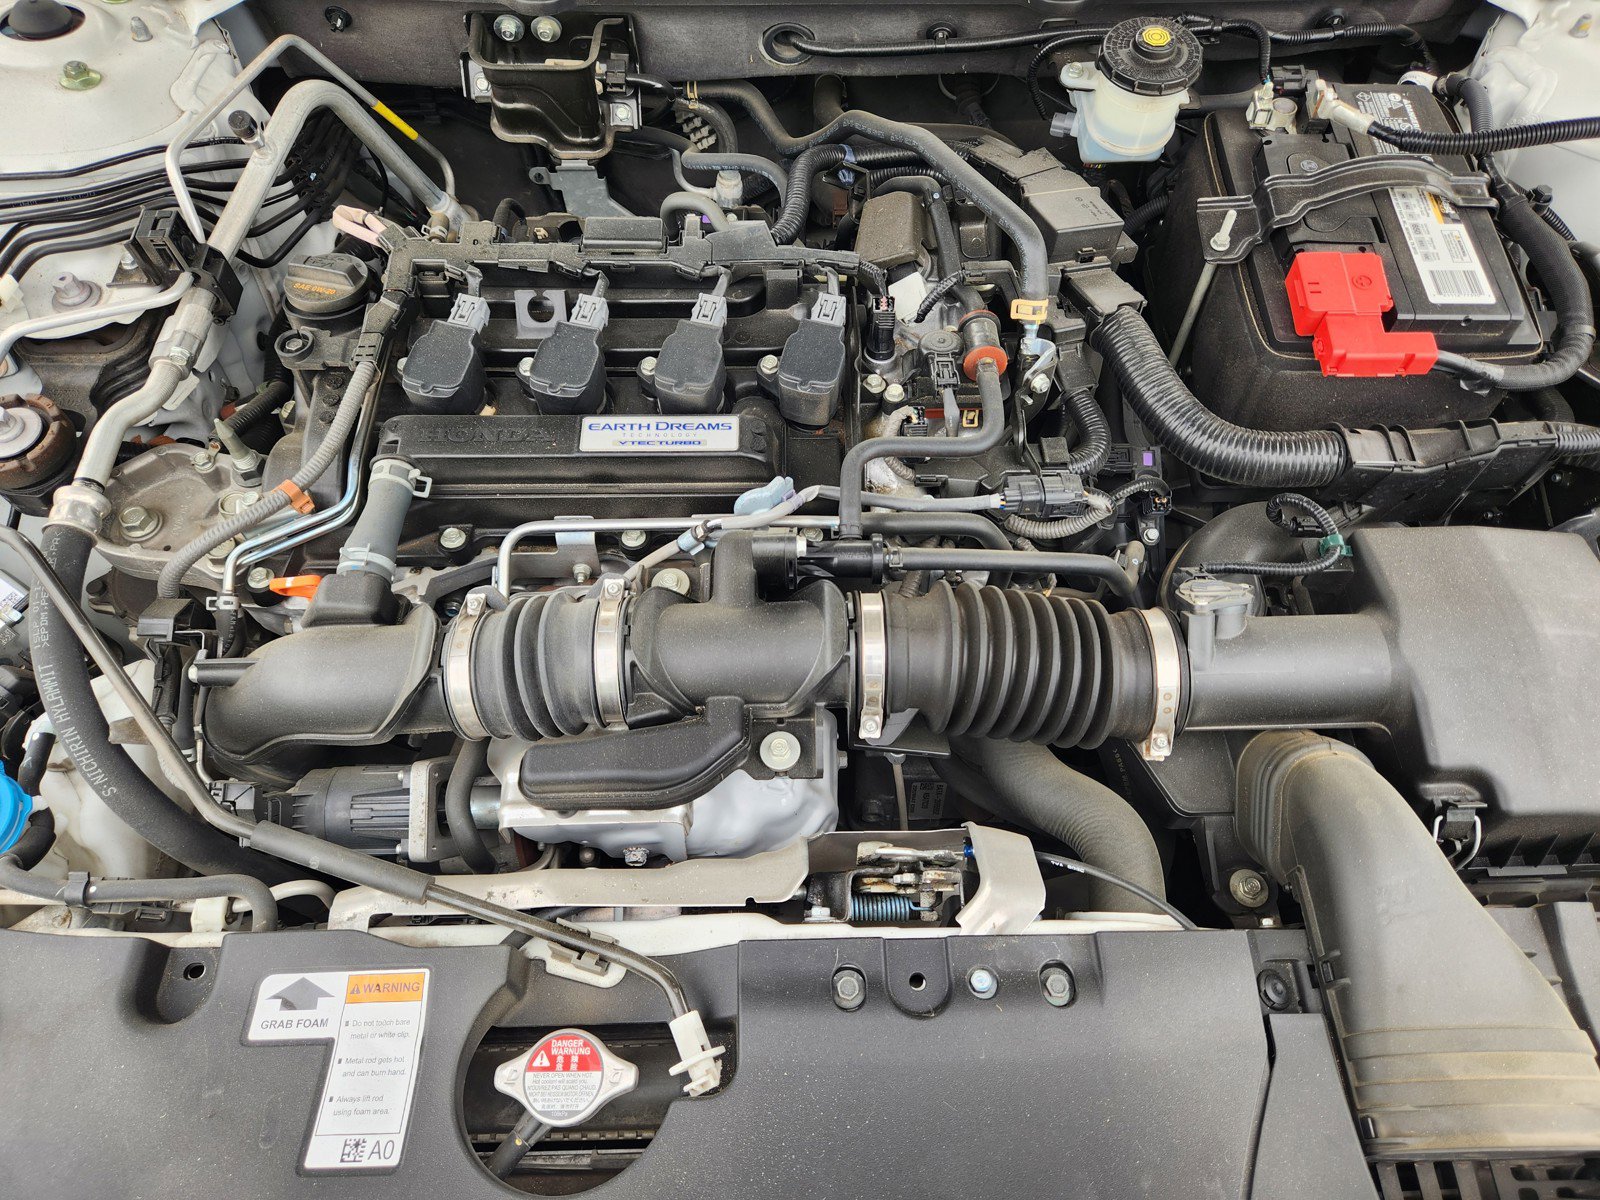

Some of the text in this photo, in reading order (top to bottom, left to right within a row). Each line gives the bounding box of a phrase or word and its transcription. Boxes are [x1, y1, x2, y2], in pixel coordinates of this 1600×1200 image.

[293, 282, 337, 295] SAE 0W-20
[588, 421, 733, 431] EARTH DREAMS
[417, 427, 551, 443] HONDA
[38, 663, 71, 725] HYLAMMIT
[363, 982, 420, 994] WARNING
[260, 1018, 329, 1030] GRAB FOAM
[396, 1018, 410, 1026] bare
[552, 1039, 584, 1048] DANGER
[551, 1047, 591, 1056] WARNUNG
[378, 1057, 392, 1065] gets
[336, 1096, 362, 1104] Always
[372, 1094, 384, 1102] rod
[333, 1108, 352, 1117] using
[368, 1140, 395, 1160] A0
